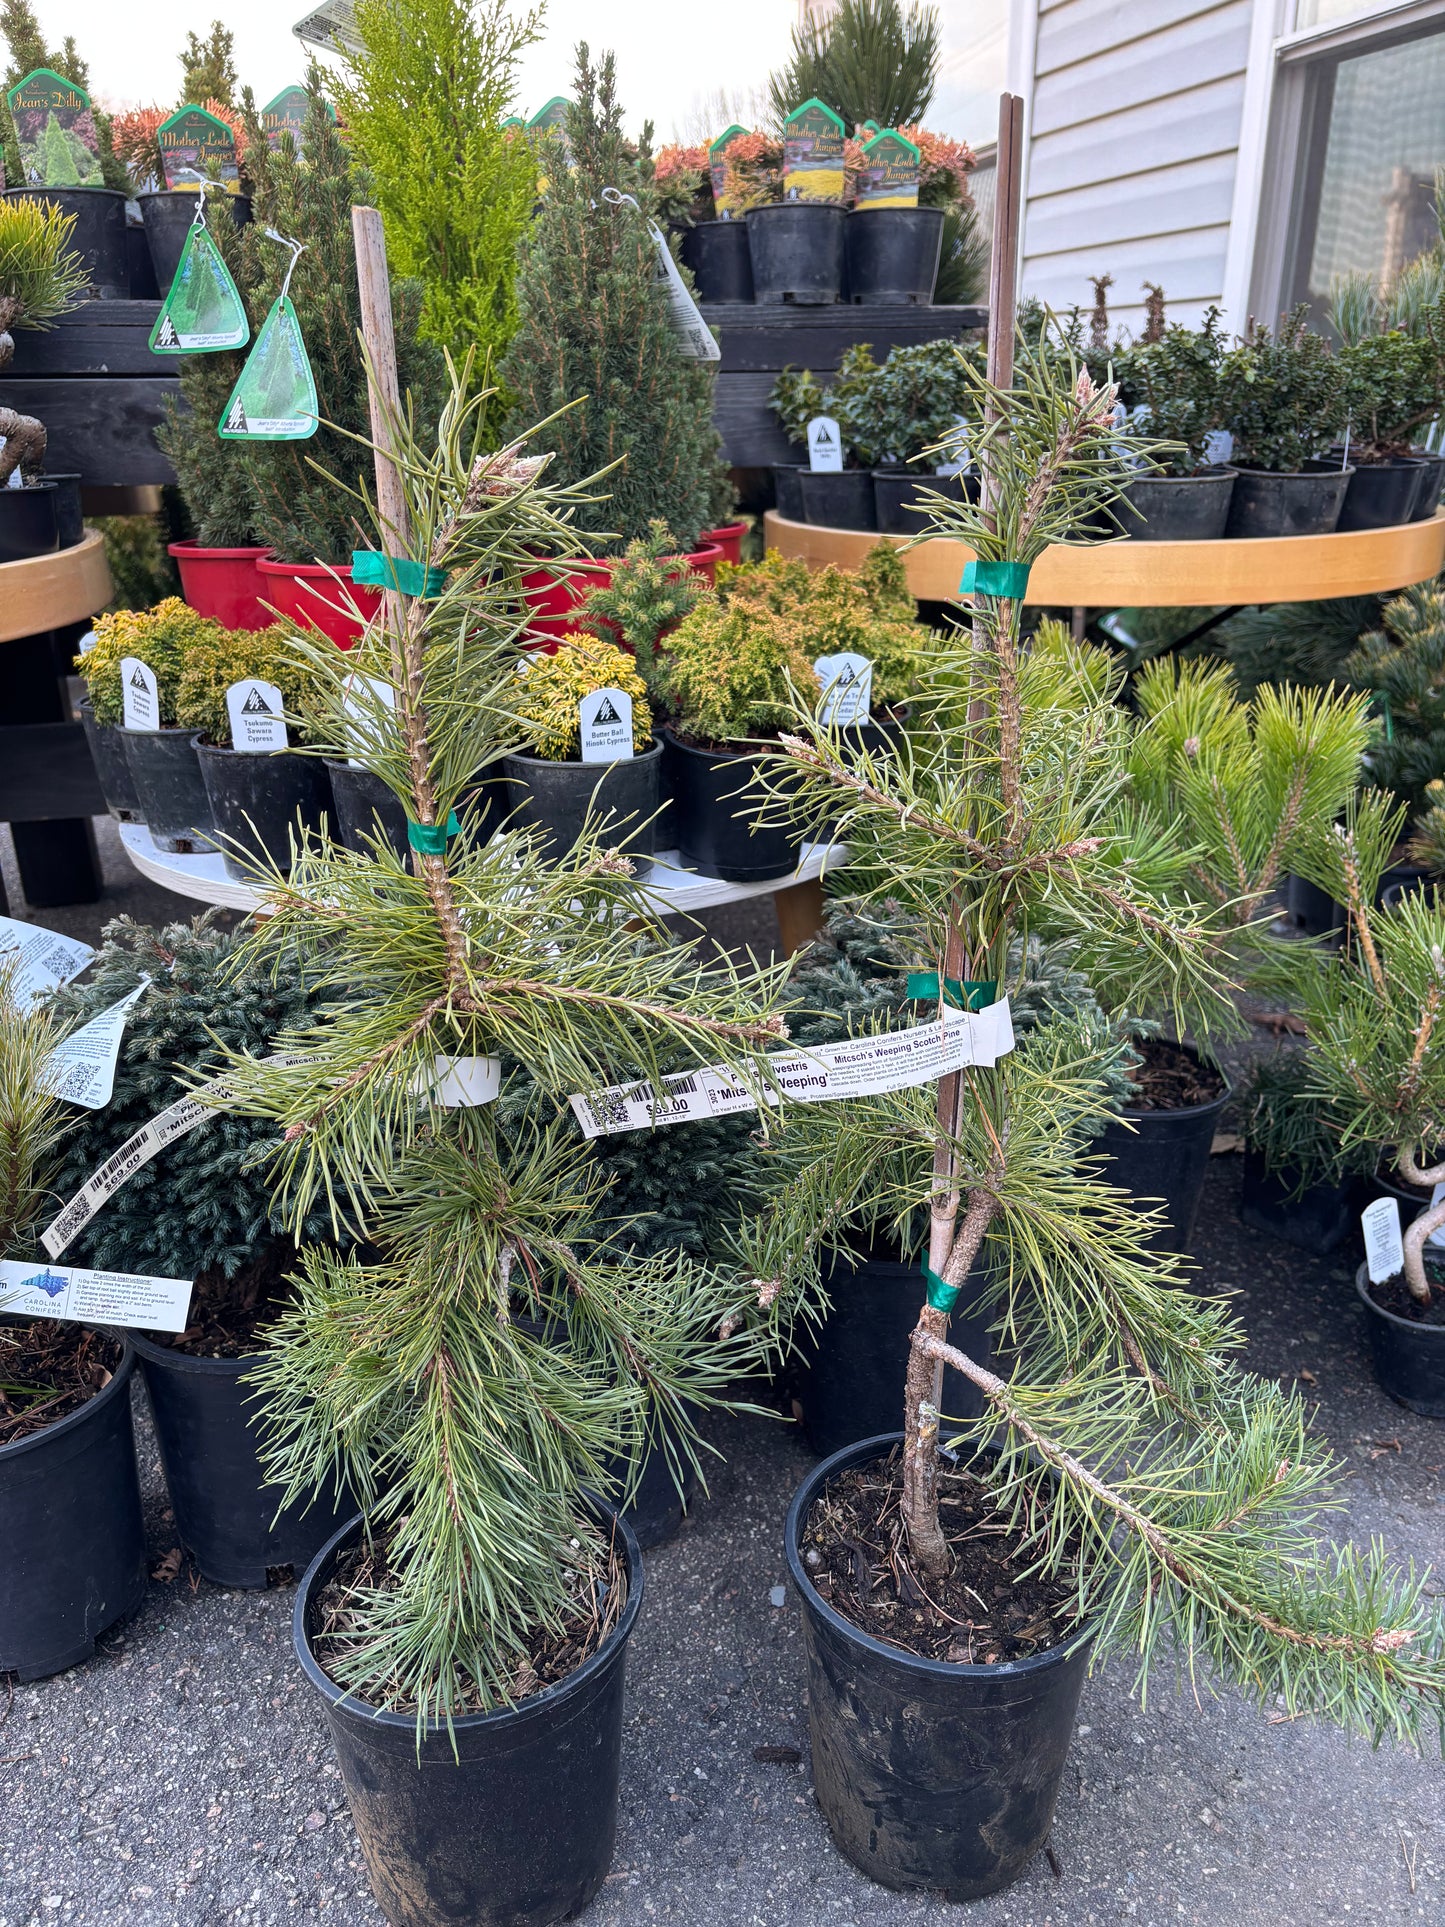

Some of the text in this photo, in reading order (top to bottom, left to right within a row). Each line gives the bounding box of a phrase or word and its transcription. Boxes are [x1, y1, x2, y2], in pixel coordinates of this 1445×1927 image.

[14, 91, 82, 111] Jean's Dilly
[264, 112, 300, 128] Mother
[162, 131, 230, 147] Mother Lode
[198, 146, 232, 162] Juniper
[865, 154, 888, 168] other
[586, 737, 630, 747] Hinoki Cypress
[849, 1039, 875, 1049] Carolina
[876, 1033, 902, 1045] Conifers
[903, 1028, 927, 1040] Nursery
[933, 1017, 966, 1031] Ladscape
[834, 1028, 961, 1064] Mitcsch's Weeping Scotch Pine
[772, 1060, 807, 1075] lvestris
[930, 1068, 946, 1077] USDA
[946, 1063, 960, 1071] Zones
[179, 1099, 198, 1113] Pin
[165, 1102, 208, 1133] 'Mitsch
[104, 1154, 140, 1191] $69.00
[23, 1298, 61, 1308] CAROLINA
[24, 1305, 61, 1315] CONIFERS
